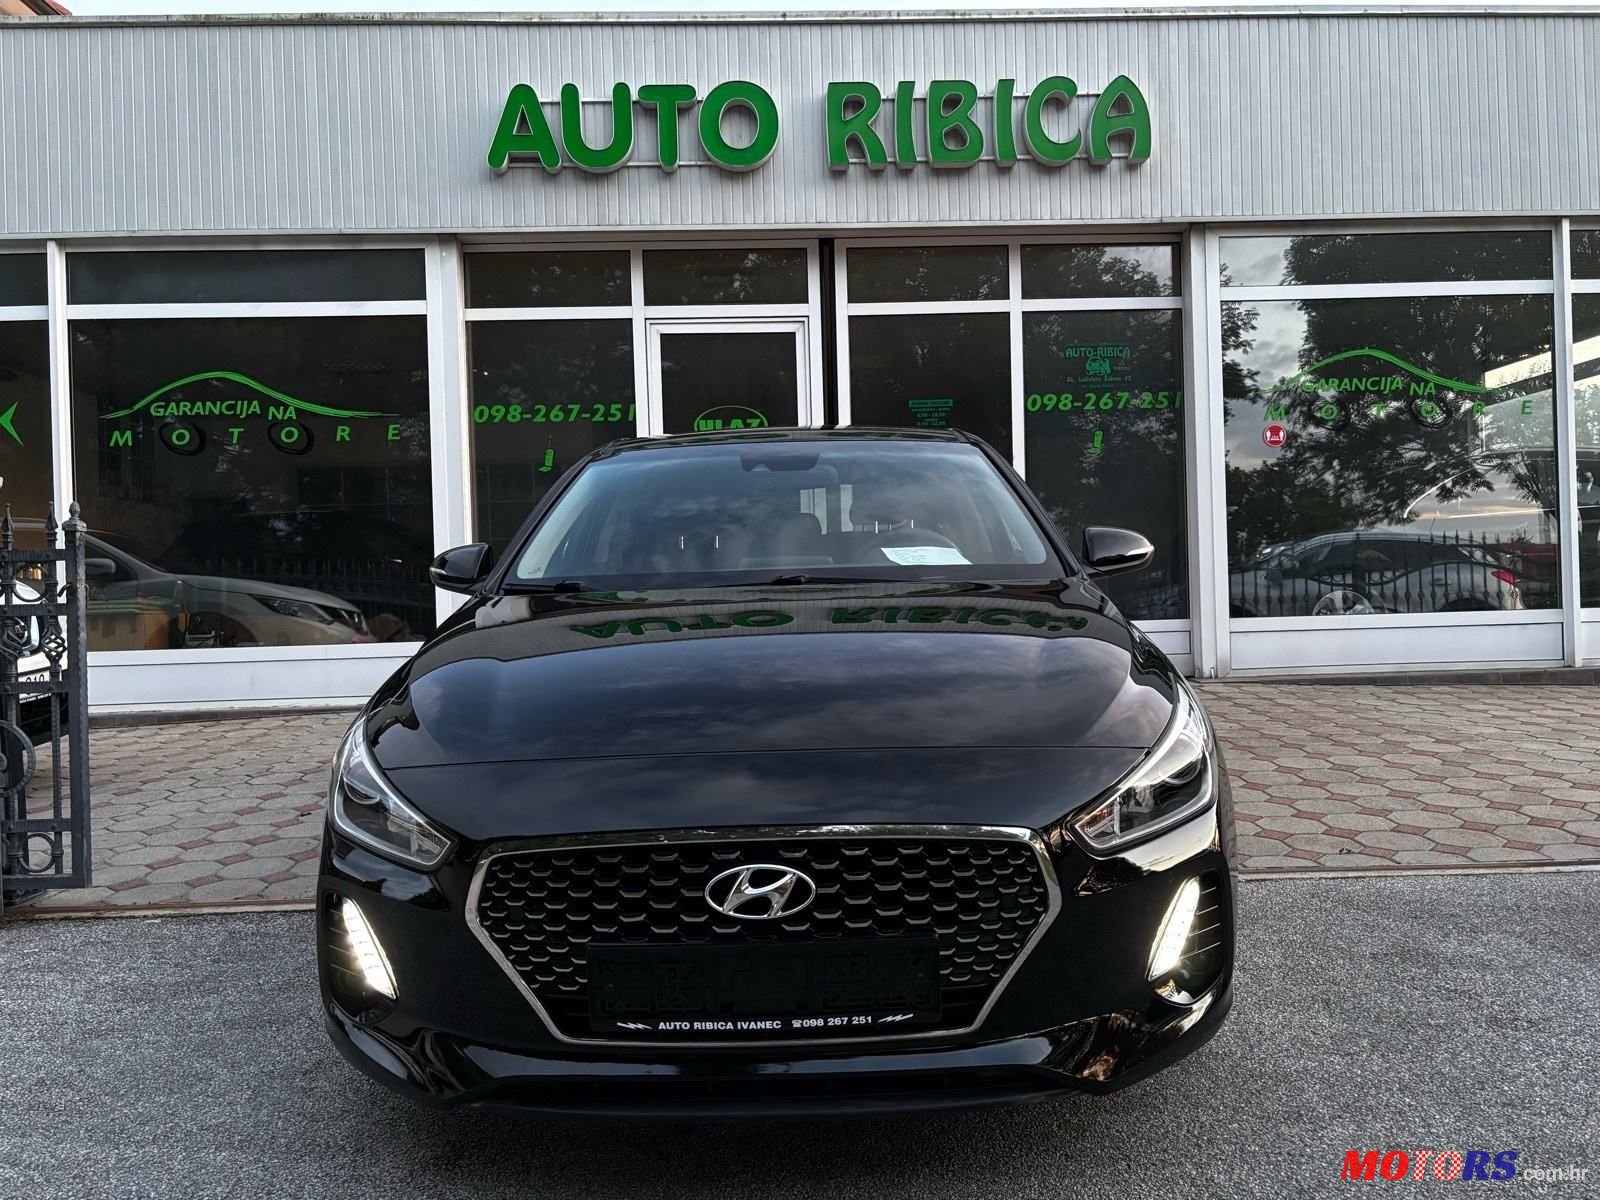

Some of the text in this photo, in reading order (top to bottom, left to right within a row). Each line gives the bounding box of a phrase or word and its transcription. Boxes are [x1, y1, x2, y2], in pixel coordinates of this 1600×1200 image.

[487, 74, 1151, 173] AUTO RIBICA
[1301, 377, 1436, 396] GARANCIJA NA
[151, 400, 297, 420] GARANCIJA NA
[1026, 391, 1182, 411] 098-267-251
[473, 403, 636, 423] 098-267-251
[658, 1016, 872, 1030] AUTO RIBICA IVANEC 098 267 251
